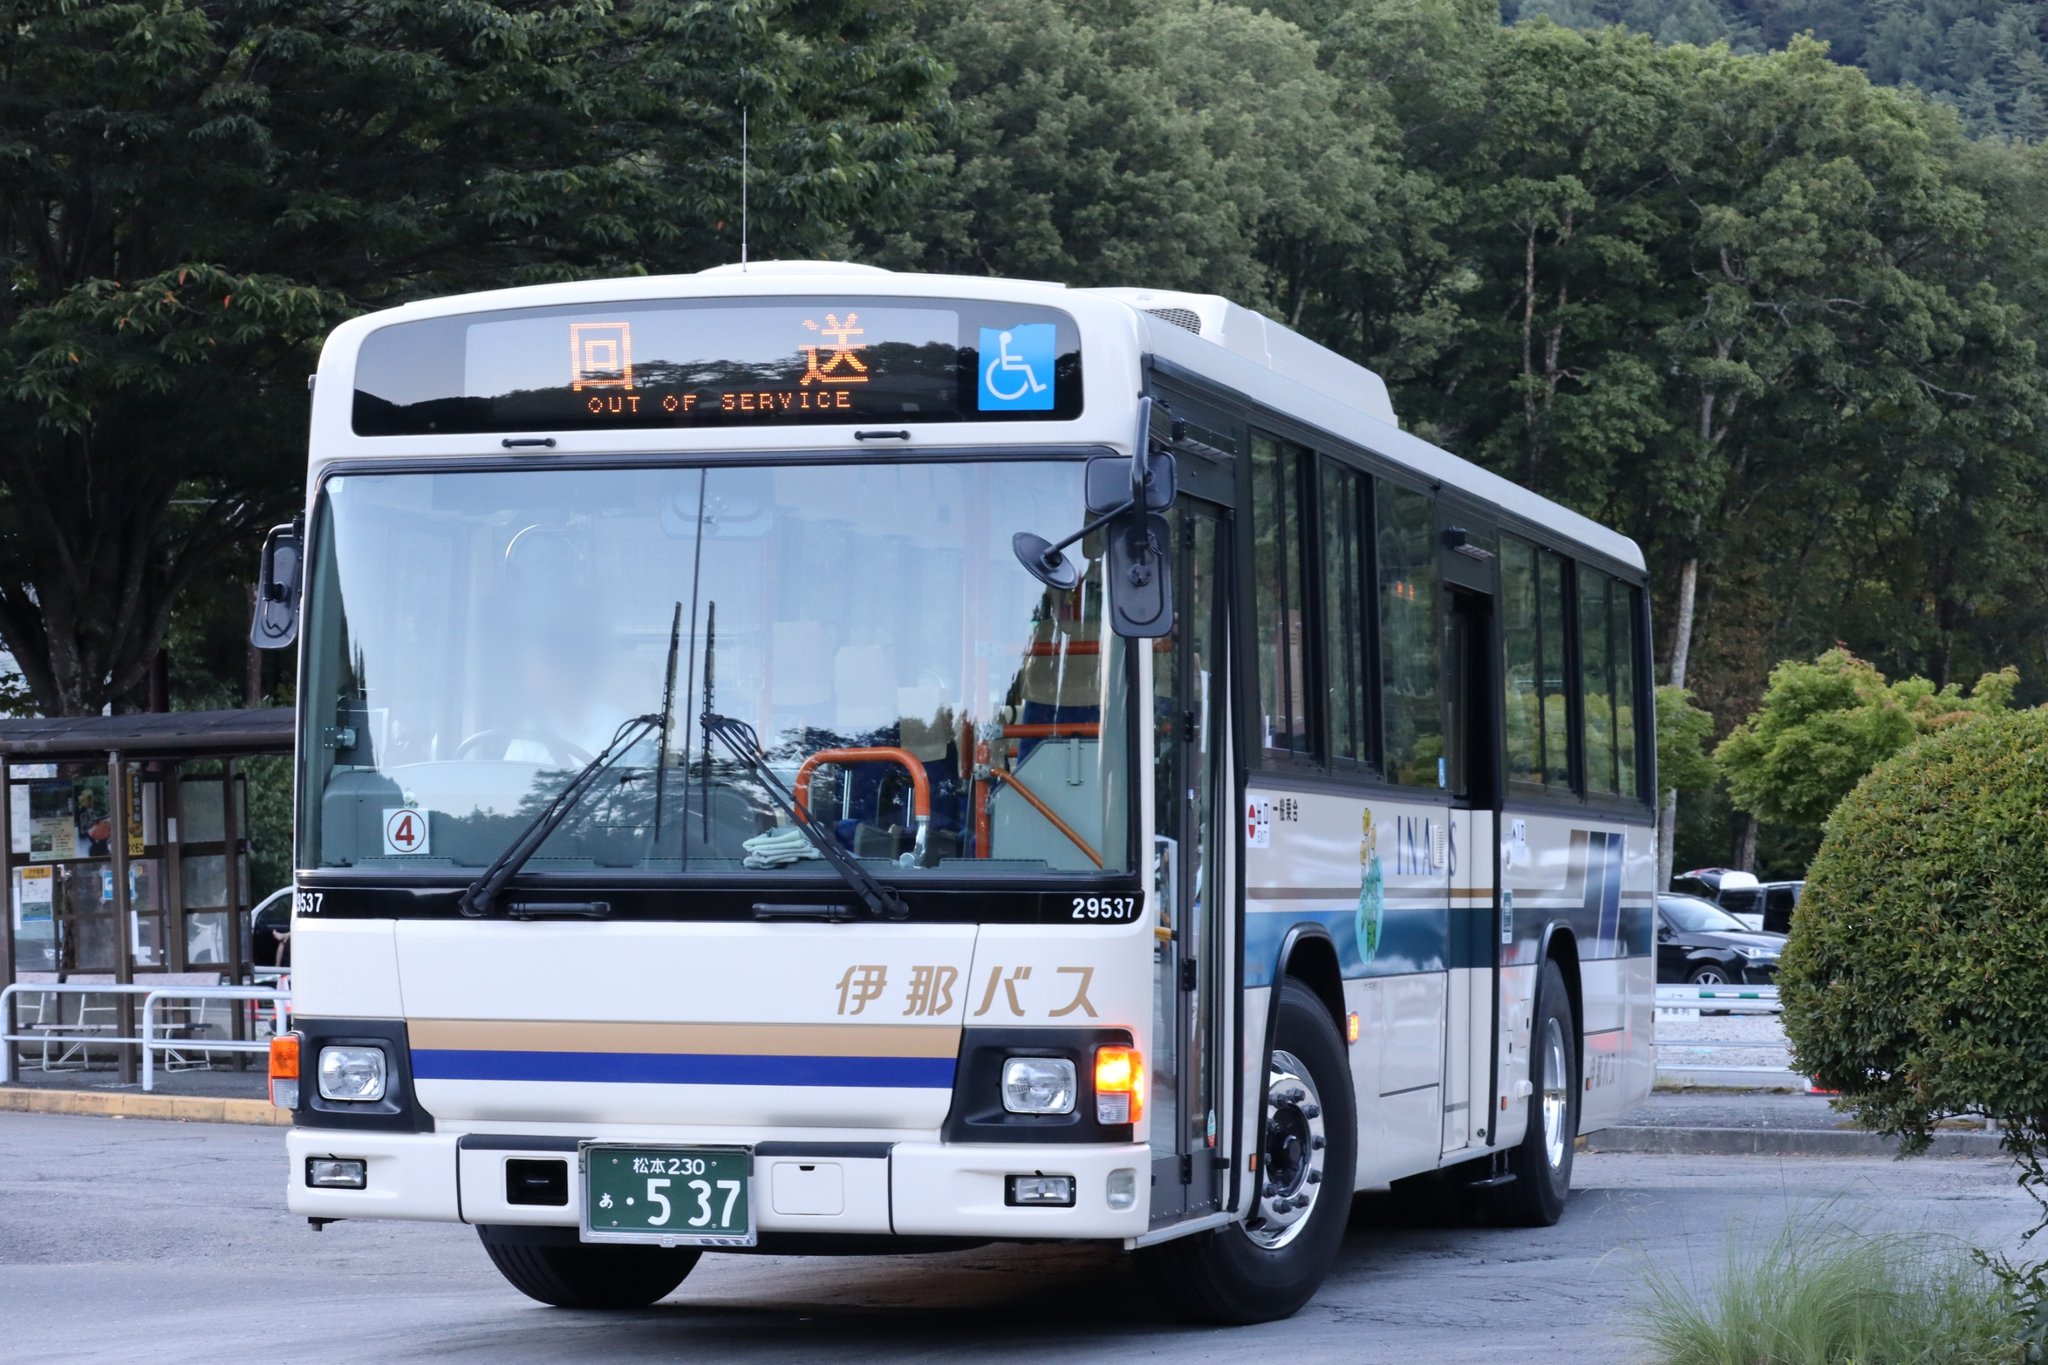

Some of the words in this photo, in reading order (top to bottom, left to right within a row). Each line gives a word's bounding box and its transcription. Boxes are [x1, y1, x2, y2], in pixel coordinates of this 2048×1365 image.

[570, 322, 633, 391] 回
[798, 313, 868, 385] 送
[588, 396, 640, 413] OUT
[663, 395, 697, 412] OF
[722, 391, 851, 410] SERVICE
[394, 815, 415, 846] 4
[1072, 897, 1135, 919] 29537
[835, 964, 1099, 1018] 伊那バス
[599, 1192, 614, 1209] あ
